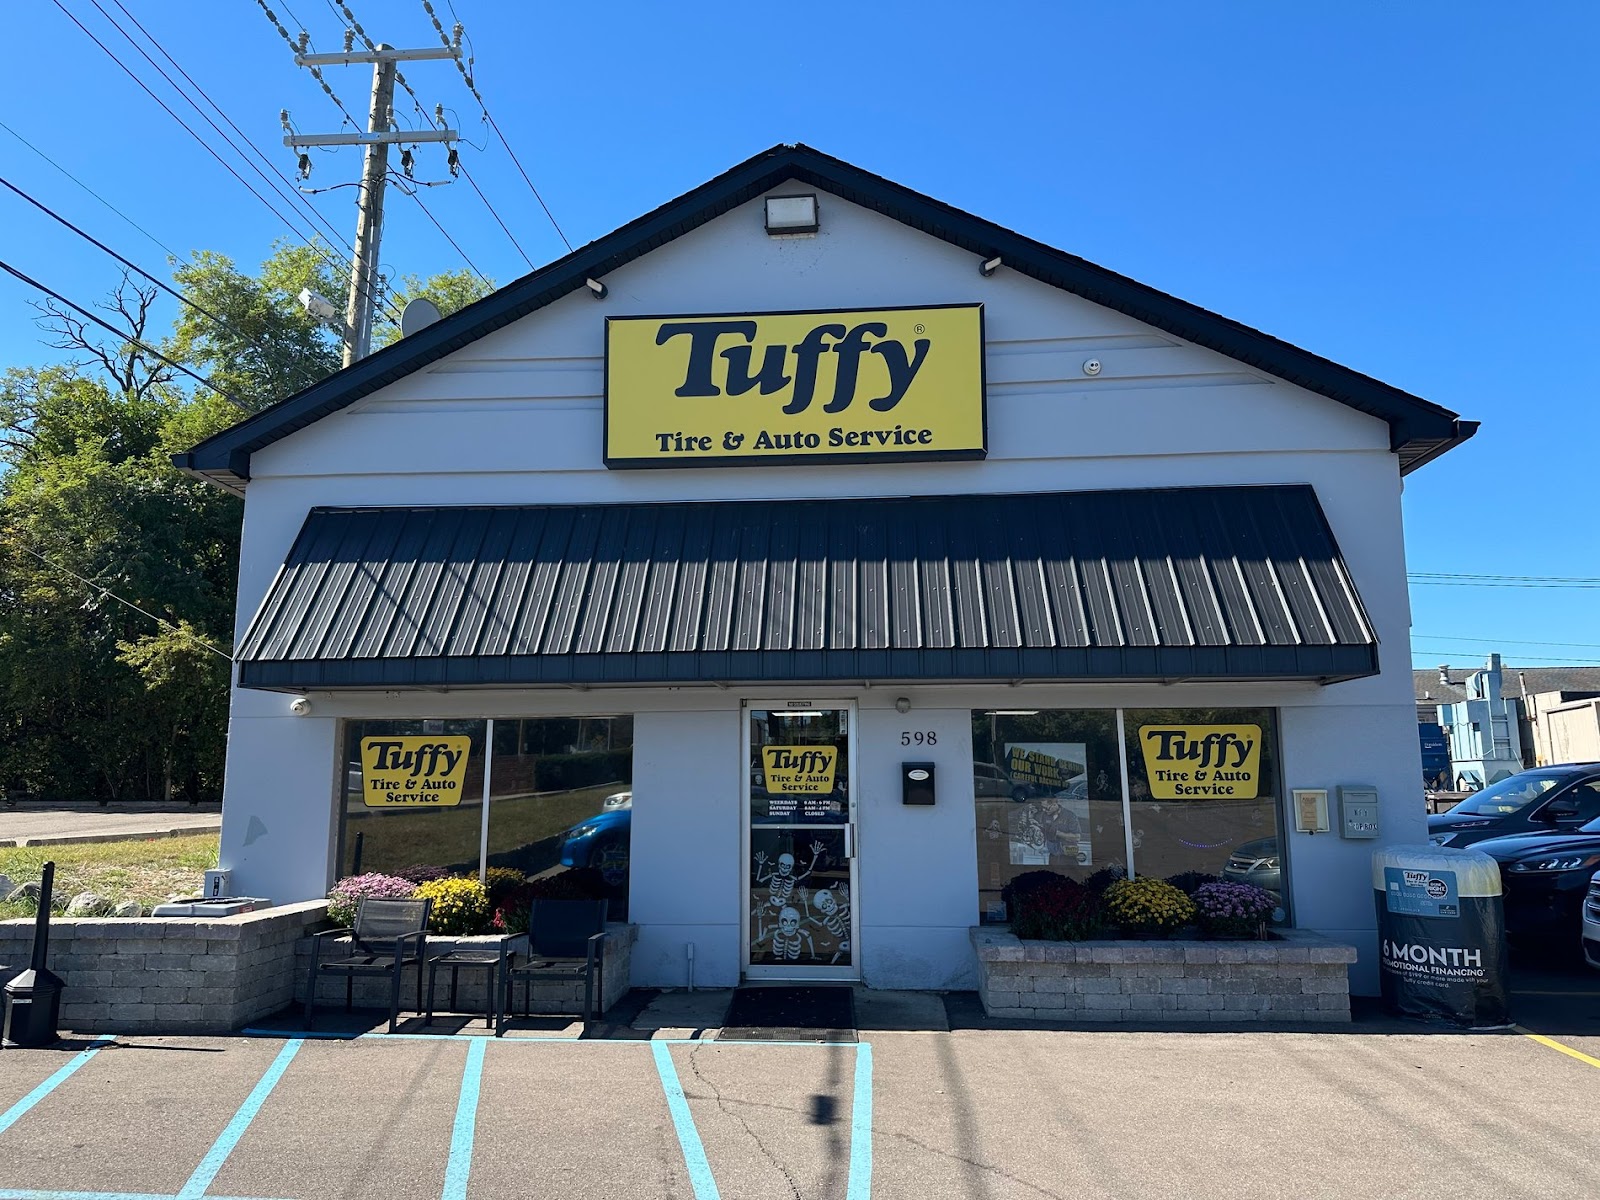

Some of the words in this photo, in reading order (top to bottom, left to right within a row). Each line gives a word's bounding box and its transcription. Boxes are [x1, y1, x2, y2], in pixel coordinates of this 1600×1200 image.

[655, 320, 931, 415] Tuffy
[655, 431, 713, 452] Tire
[722, 431, 745, 451] &
[753, 430, 820, 450] Auto
[828, 425, 933, 447] Service
[901, 731, 938, 746] 598
[1011, 746, 1026, 759] WE
[1147, 730, 1254, 768] Tuffy
[367, 742, 462, 777] Tuffy
[767, 749, 832, 774] Tuffy
[1011, 758, 1032, 772] OUR
[771, 774, 791, 782] Tire
[794, 774, 802, 782] &
[806, 774, 829, 782] Auto
[1155, 770, 1189, 781] Tire
[1194, 770, 1207, 781] &
[1213, 770, 1251, 781] Auto
[371, 778, 400, 790] Tire
[405, 779, 417, 790] &
[421, 779, 456, 790] Auto
[782, 783, 818, 791] Service
[1175, 783, 1234, 795] Service
[386, 791, 439, 802] Service
[1383, 939, 1390, 957] 6
[1392, 941, 1482, 967] MONTH
